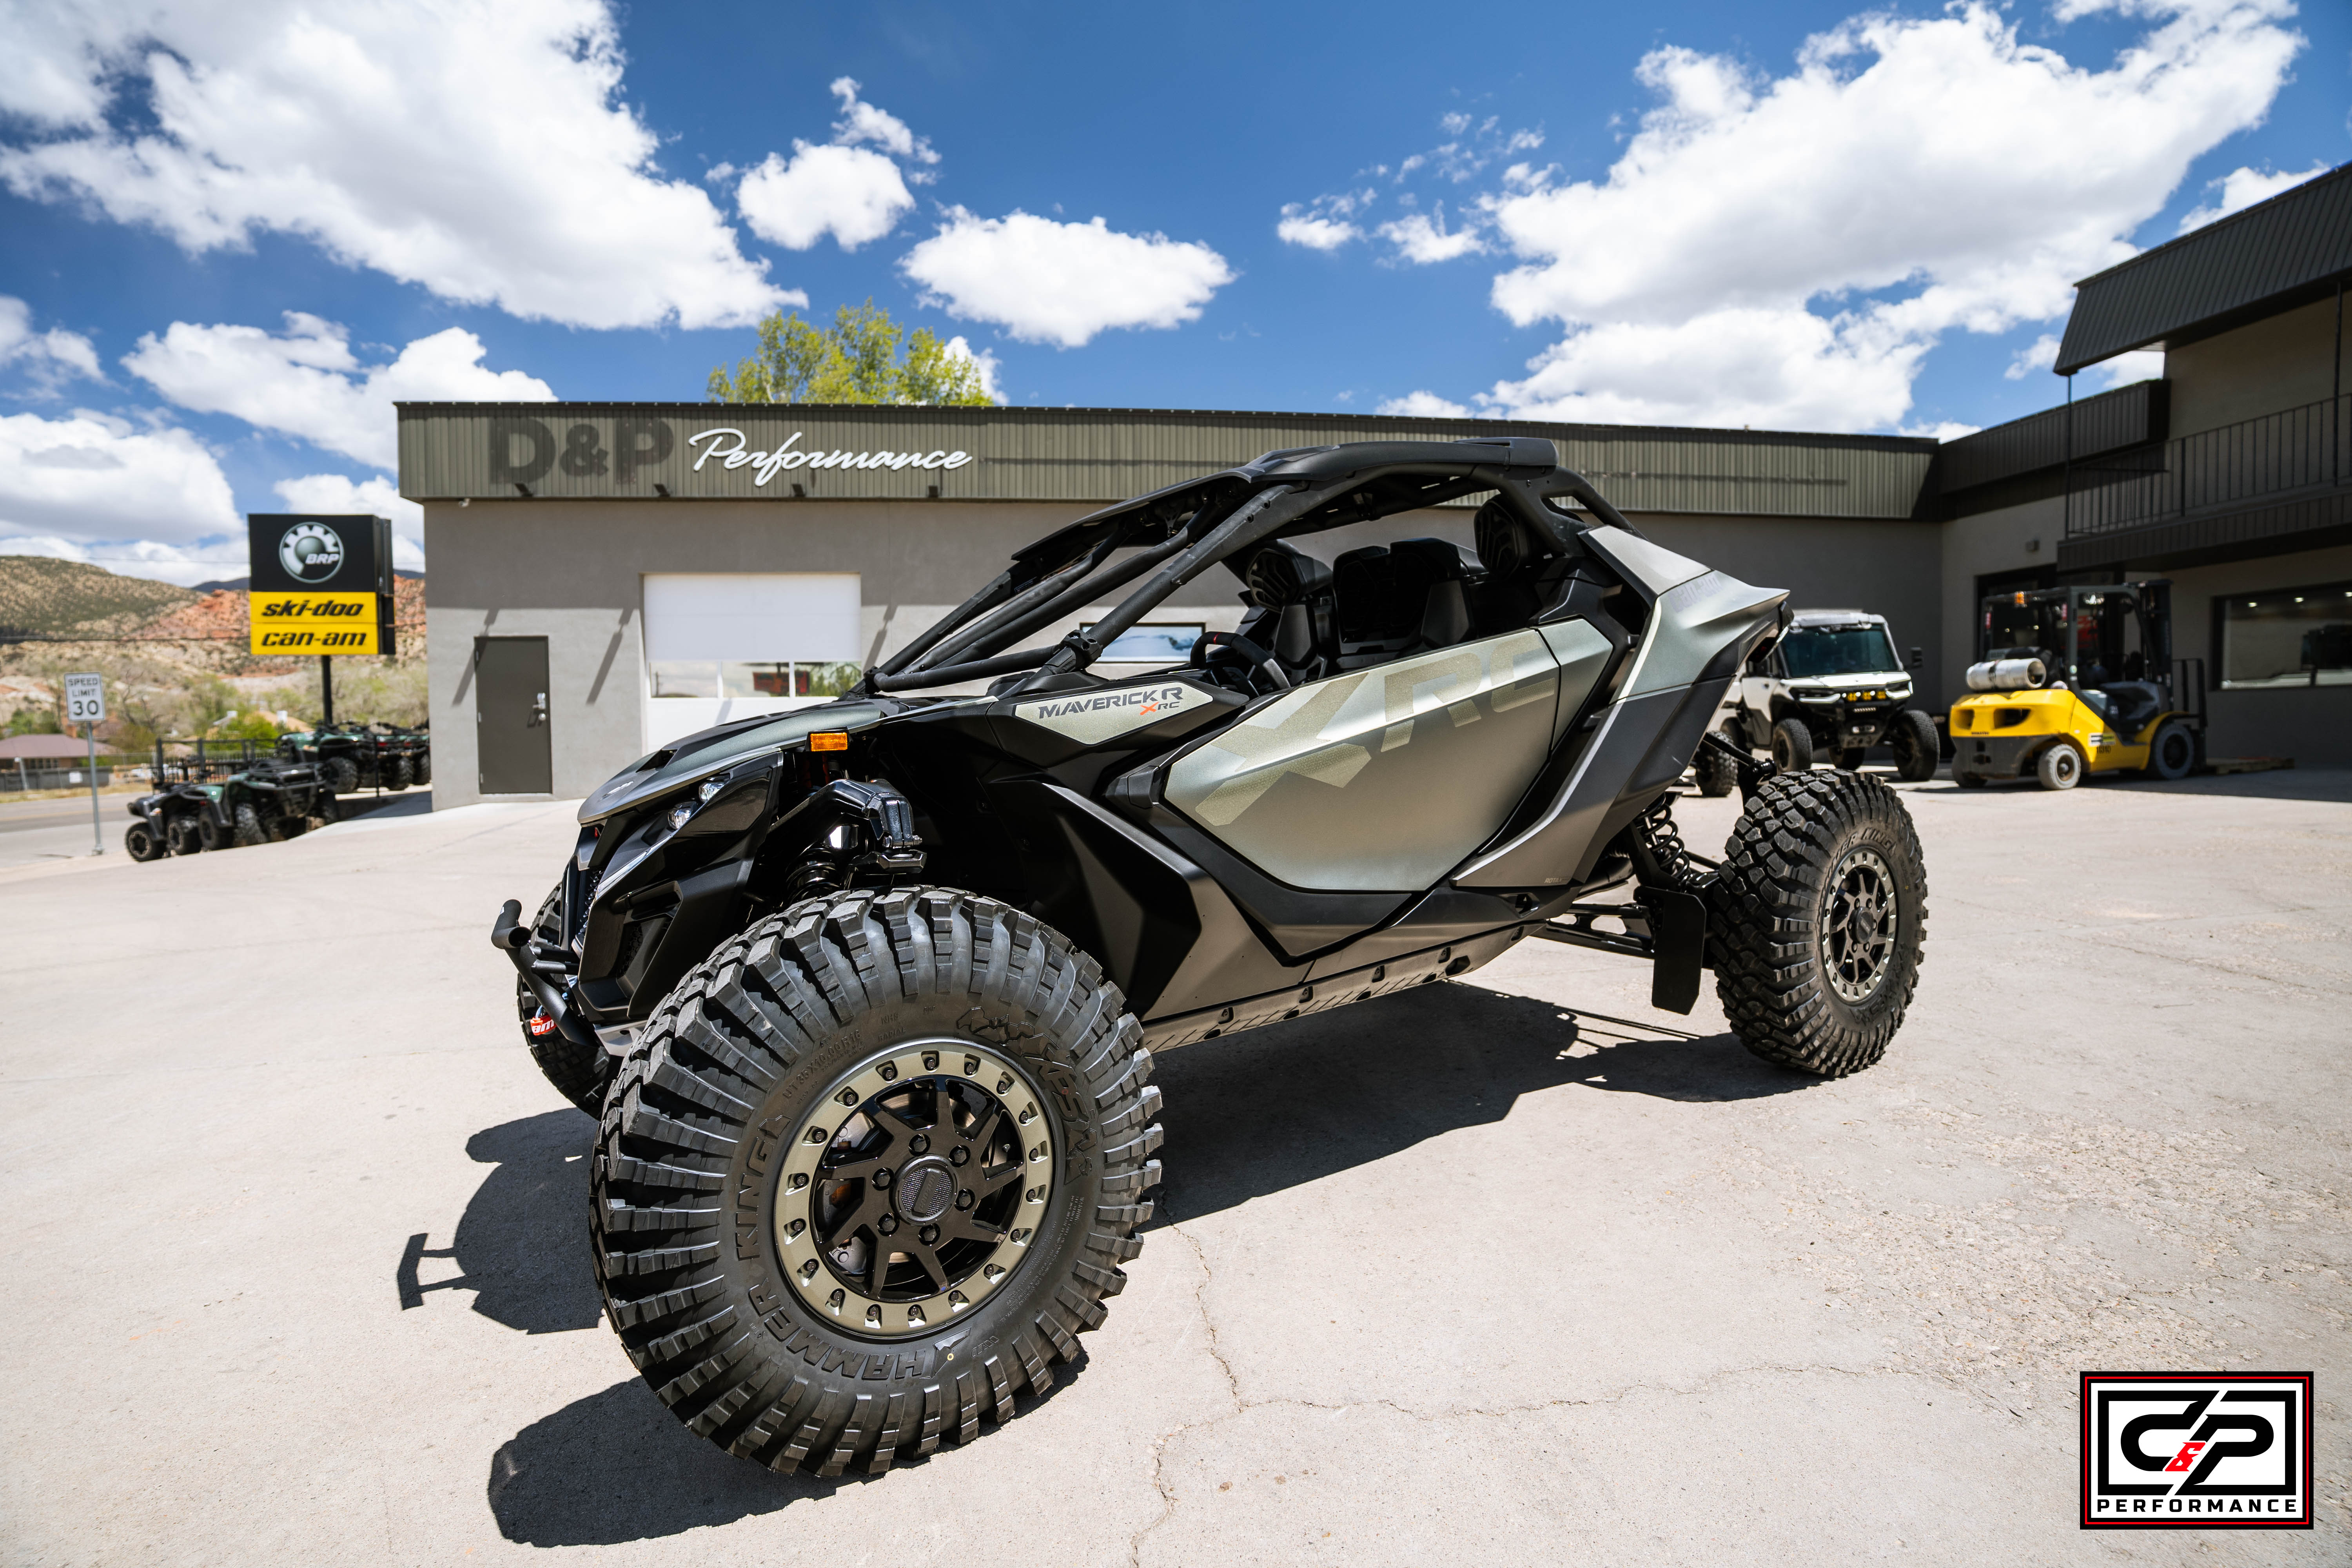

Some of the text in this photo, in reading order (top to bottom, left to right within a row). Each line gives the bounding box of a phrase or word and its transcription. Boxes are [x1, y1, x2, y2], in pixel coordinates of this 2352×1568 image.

[487, 416, 973, 487] D&P Performance
[305, 553, 340, 565] BRP
[261, 599, 365, 617] ski-doo
[261, 632, 367, 646] can-am
[68, 678, 98, 687] SPEED
[72, 688, 96, 697] LIMIT
[73, 700, 99, 716] 30
[1038, 689, 1158, 719] MAVERICK
[735, 1136, 775, 1261] KING
[747, 1276, 928, 1381] HAMMER
